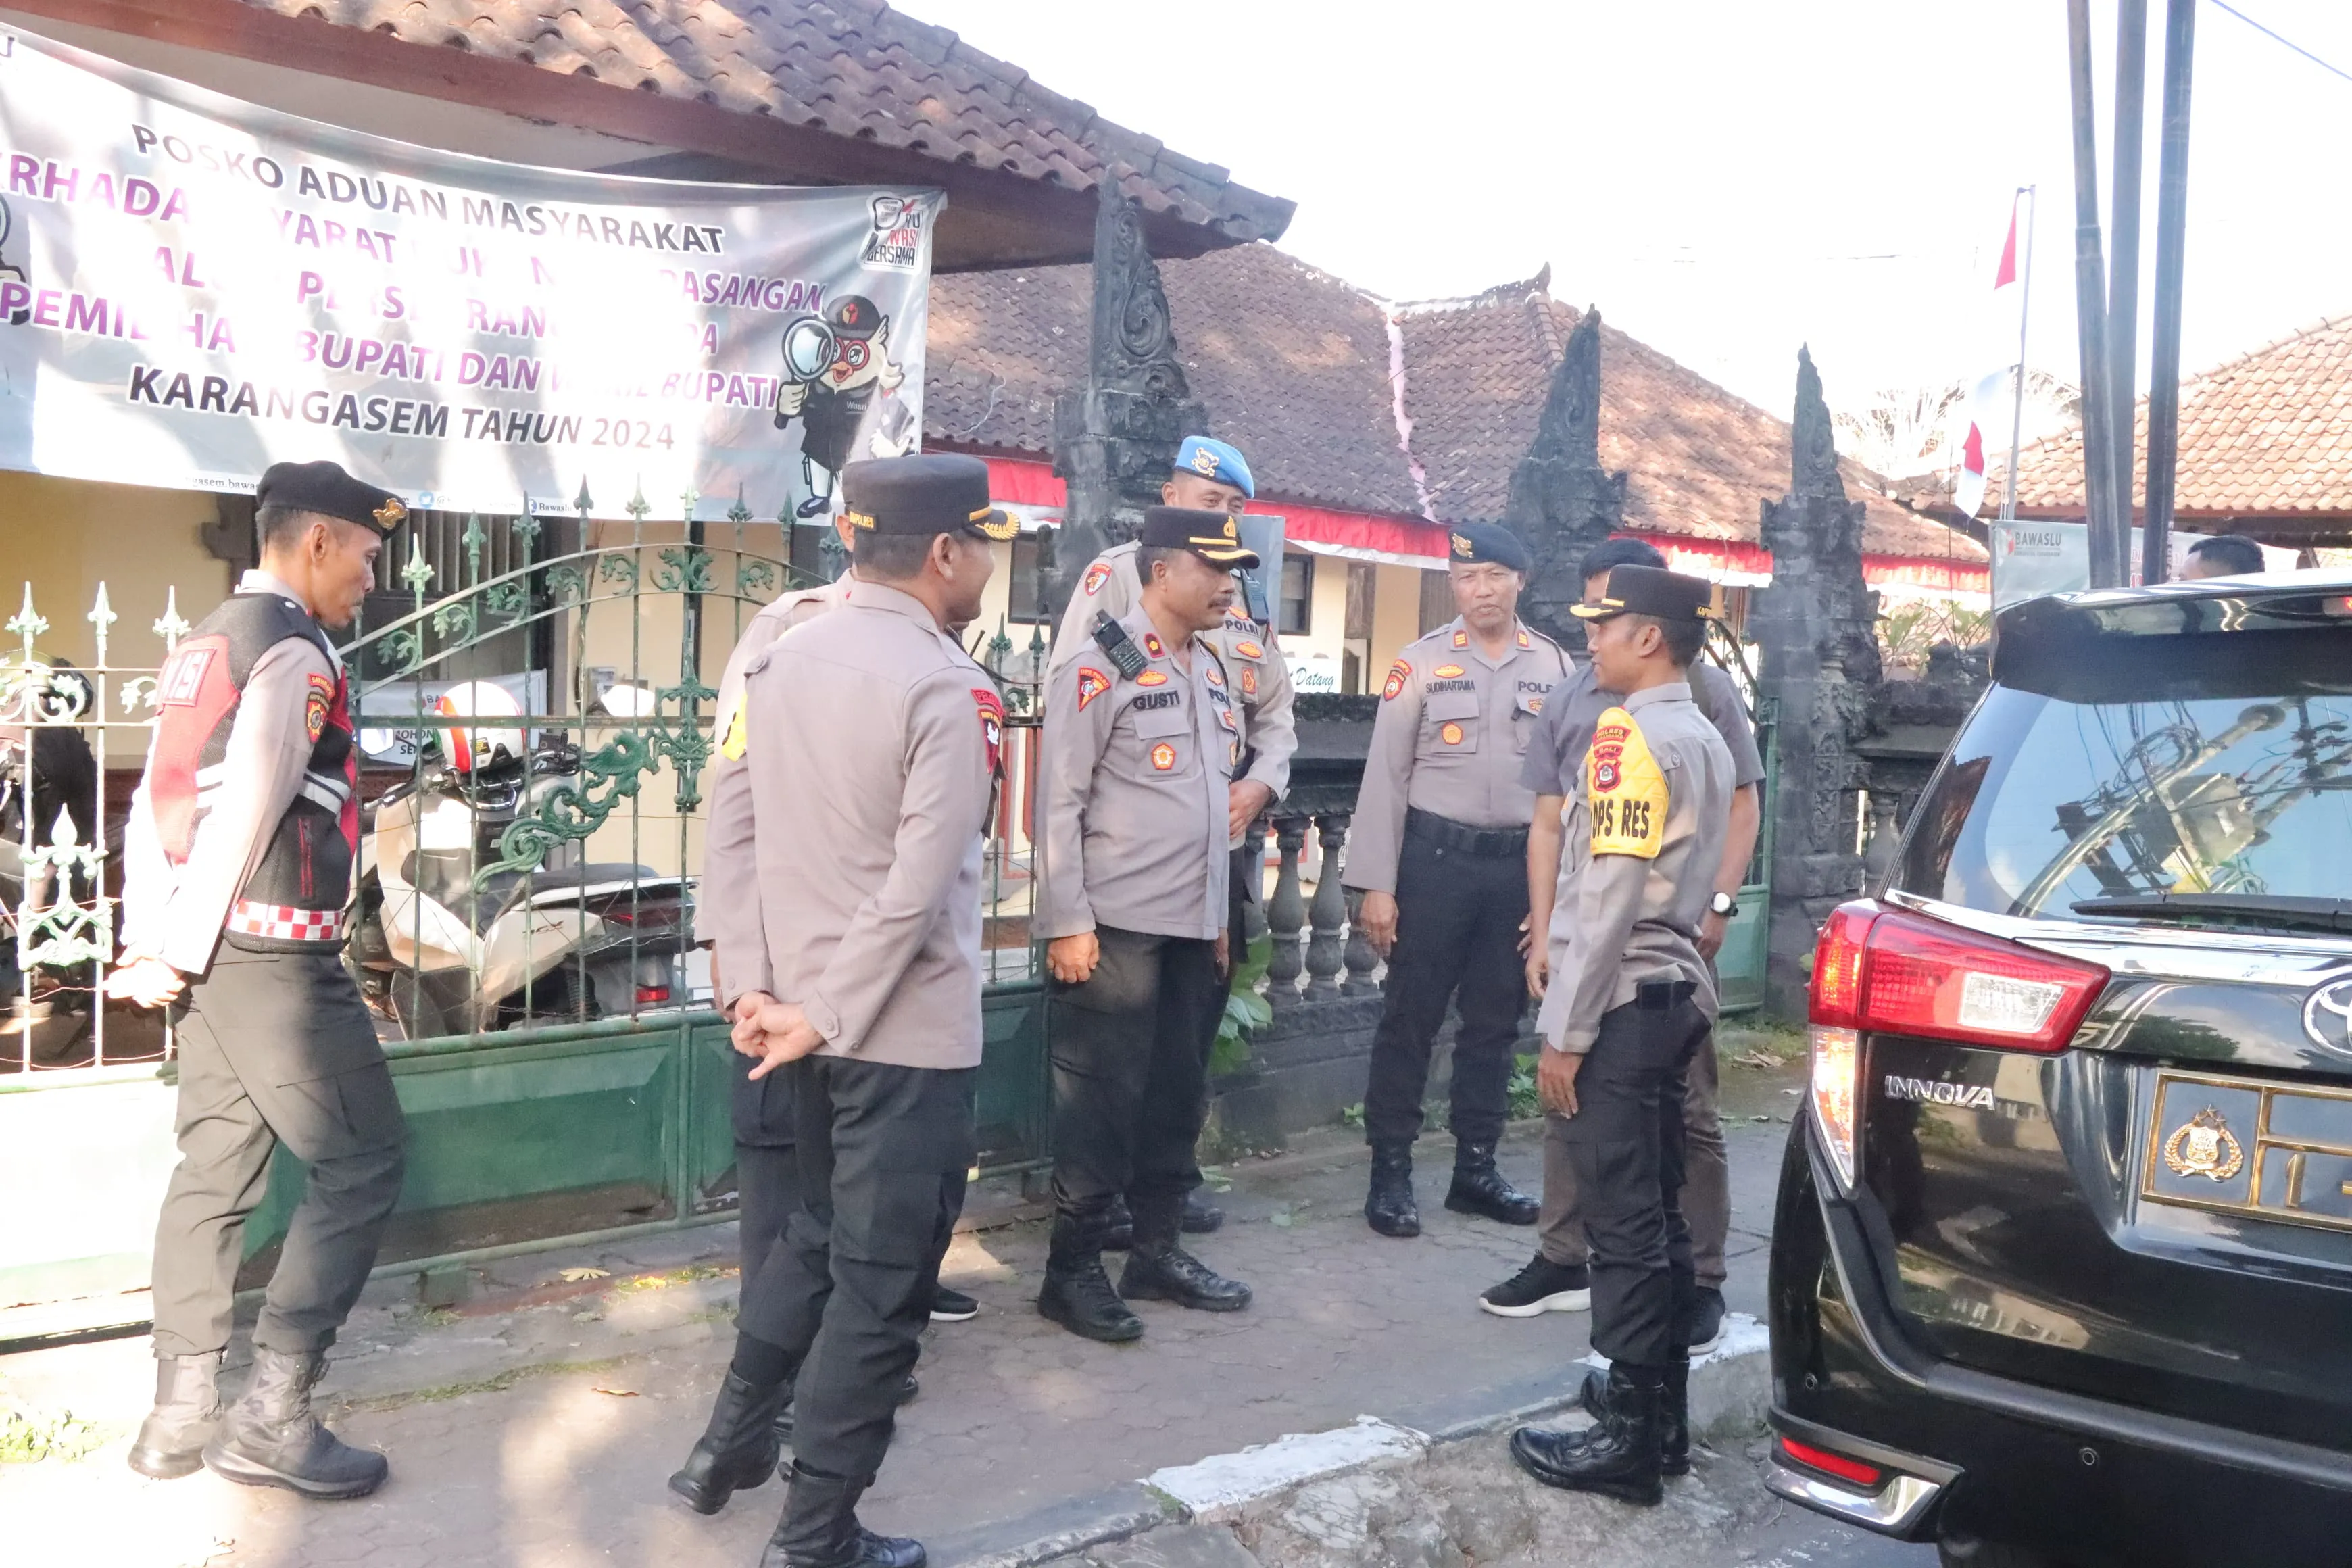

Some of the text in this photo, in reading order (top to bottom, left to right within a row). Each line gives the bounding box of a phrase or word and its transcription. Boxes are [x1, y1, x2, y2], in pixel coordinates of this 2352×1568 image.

[0, 153, 191, 224] RHADA
[132, 124, 724, 253] POSKO ADUAN MASYARAKAT
[867, 245, 916, 266] BERSAMA
[295, 330, 445, 381] BUPATI
[458, 352, 541, 391] DAN
[660, 372, 778, 408] BUPATI
[130, 366, 675, 450] KARANGASEM TAHUN 2024
[2015, 531, 2061, 546] BAWASLU
[1225, 620, 1259, 636] POLRI
[1296, 666, 1335, 693] Datang
[1133, 690, 1180, 710] GUSTI
[1621, 799, 1650, 839] RES
[1884, 1075, 1995, 1110] INNOVA
